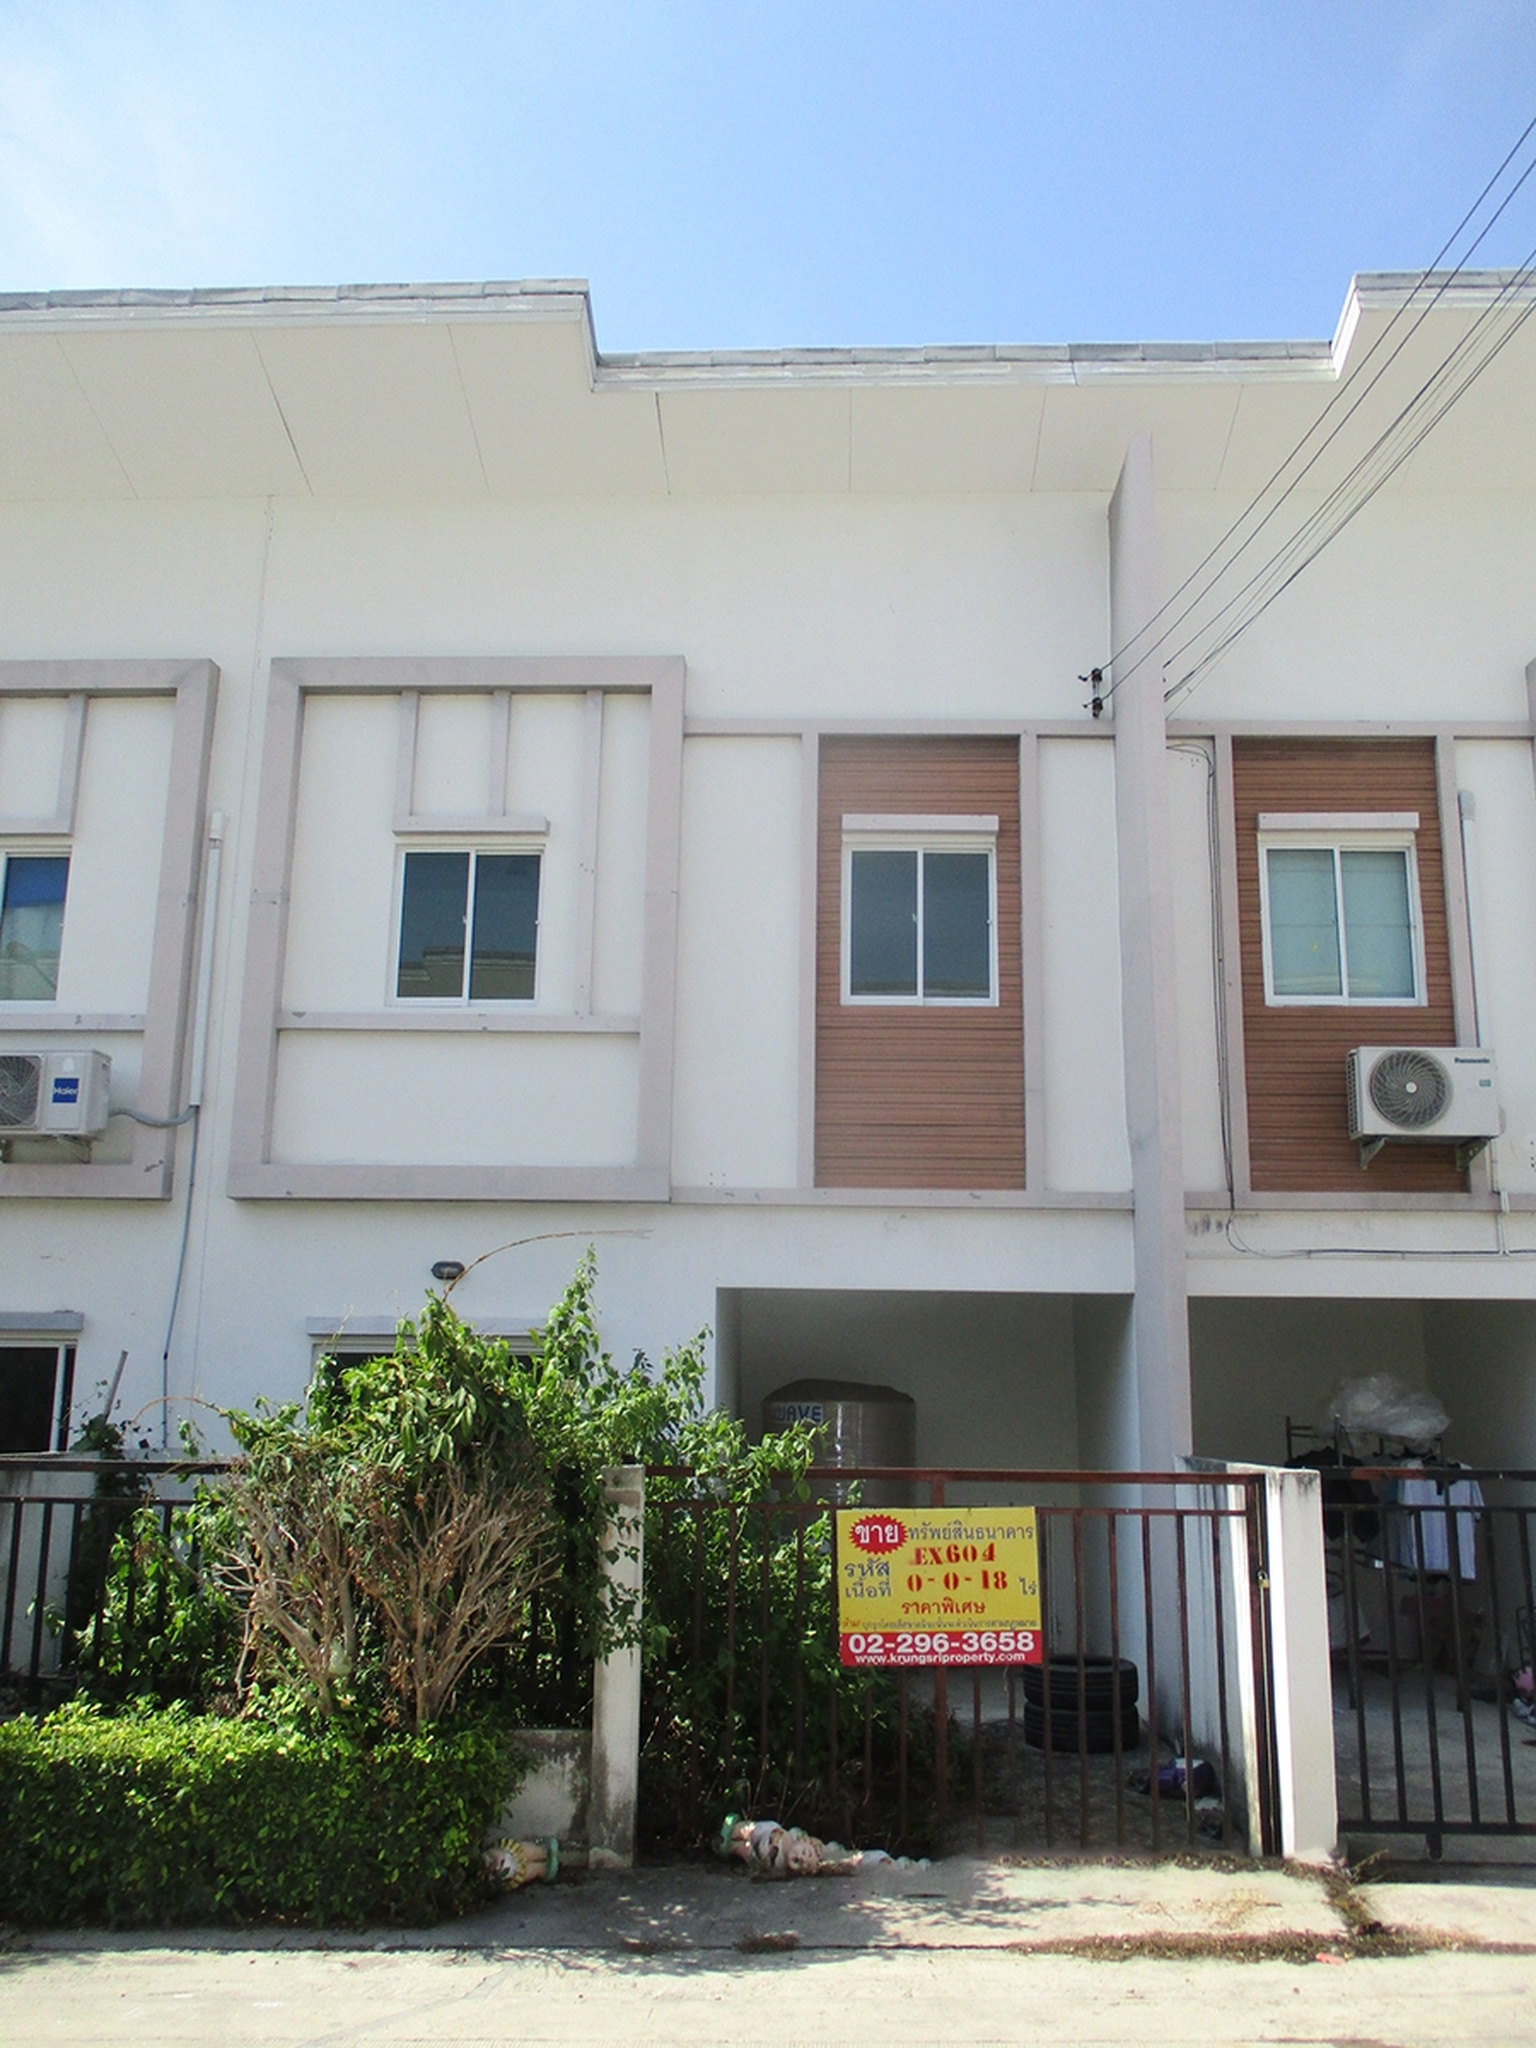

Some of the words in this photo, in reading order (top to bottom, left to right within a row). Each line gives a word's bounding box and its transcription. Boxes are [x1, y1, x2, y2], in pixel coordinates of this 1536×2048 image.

[854, 1524, 899, 1544] ขาย
[908, 1519, 1034, 1541] ทรัพย์สินธนาคาร
[844, 1558, 891, 1578] รหัส
[911, 1543, 996, 1565] EX604
[845, 1577, 892, 1598] เนื้อที่
[1018, 1576, 1037, 1596] ไร่
[902, 1597, 986, 1615] ราคาพิเศษ
[849, 1632, 1035, 1654] 02-296-3658
[855, 1652, 1025, 1664] www.krungsriproperty.com
